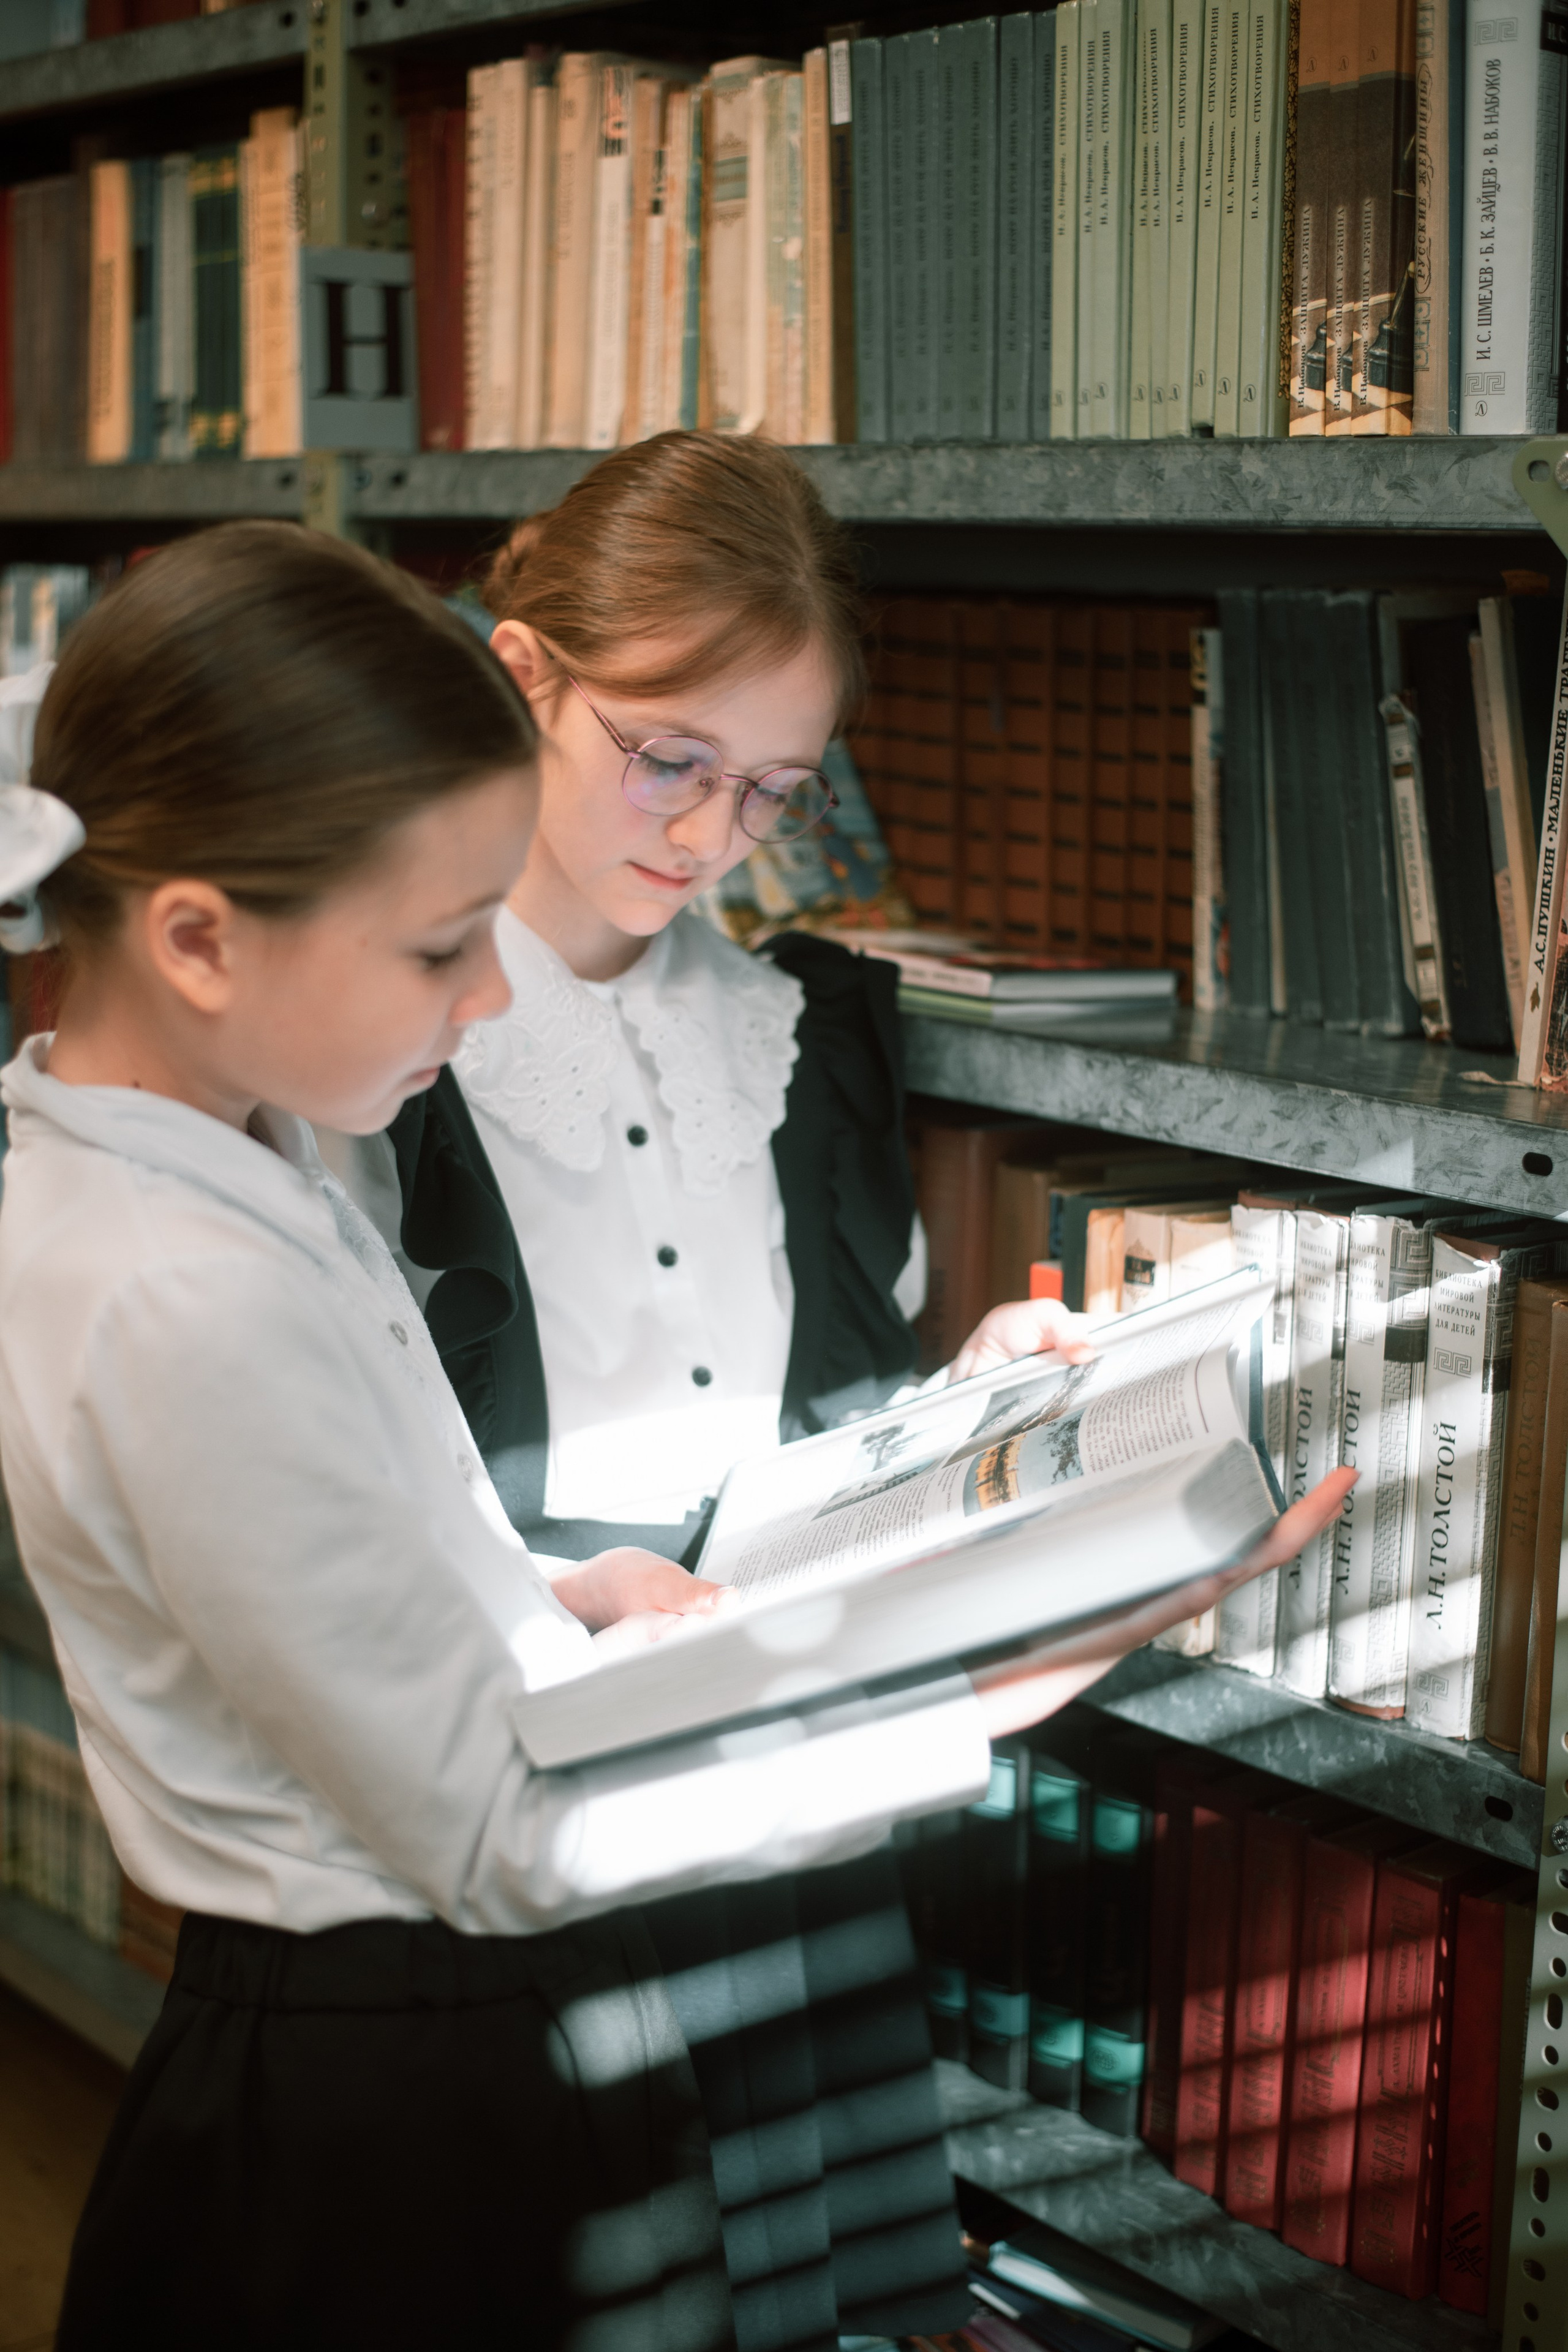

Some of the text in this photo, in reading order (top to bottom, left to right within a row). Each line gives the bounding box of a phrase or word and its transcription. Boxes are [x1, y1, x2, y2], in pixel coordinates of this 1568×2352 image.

[1100, 30, 1110, 134] СТИХОТВОРЕНИЯ
[1150, 28, 1159, 134] СТИХОТВОРЕНИЯ
[1176, 23, 1188, 223] Н. А. Некрасов. СТИХОТВОРЕНИЯ
[1204, 7, 1219, 208] Н. А. Некрасов. СТИХОТВОРЕНИЯ
[1226, 11, 1239, 214] Н. А. Некрасов. СТИХОТВОРЕНИЯ
[1251, 15, 1264, 220] Н. А. Некрасов. СТИХОТВОРЕНИЯ
[1417, 78, 1428, 280] РУССКИЕ ЖЕНЩИНЫ
[1476, 58, 1501, 360] И. С. ШМЕЛЕВ Б. К. ЗАЙЦЕВ В. В. НАБОКОВ
[1302, 207, 1310, 270] ЛУЖИНА
[1336, 208, 1344, 271] ЛУЖИНА
[1363, 200, 1372, 264] ЛУЖИНА
[311, 280, 413, 398] Н
[1300, 275, 1308, 335] ЗАЩИТА
[1362, 270, 1370, 330] ЗАЩИТА
[1533, 846, 1556, 974] А.С.ПУШКИН
[1547, 709, 1568, 832] МАЛЕНЬКИЕ
[1300, 1240, 1332, 1257] ИБЛИОТЕКА
[1350, 1273, 1384, 1288] ЕРАТУРЫ
[1351, 1240, 1385, 1256] БЛИОТЕКА
[1351, 1256, 1378, 1271] ИРОВОЙ
[1435, 1268, 1482, 1288] БИБЛИОТЕКА
[1434, 1302, 1480, 1321] ЛИТЕРАТУРЫ
[1435, 1318, 1475, 1336] ДЛЯ ДЕТЕЙ
[1440, 1287, 1474, 1303] МИРОВОЙ
[1515, 1337, 1542, 1481] ТОЛСТОЙ
[1335, 1388, 1361, 1595] Л.Н.ТОСТОЙ
[1426, 1420, 1457, 1630] Л.Н.ТОЛСТОЙ
